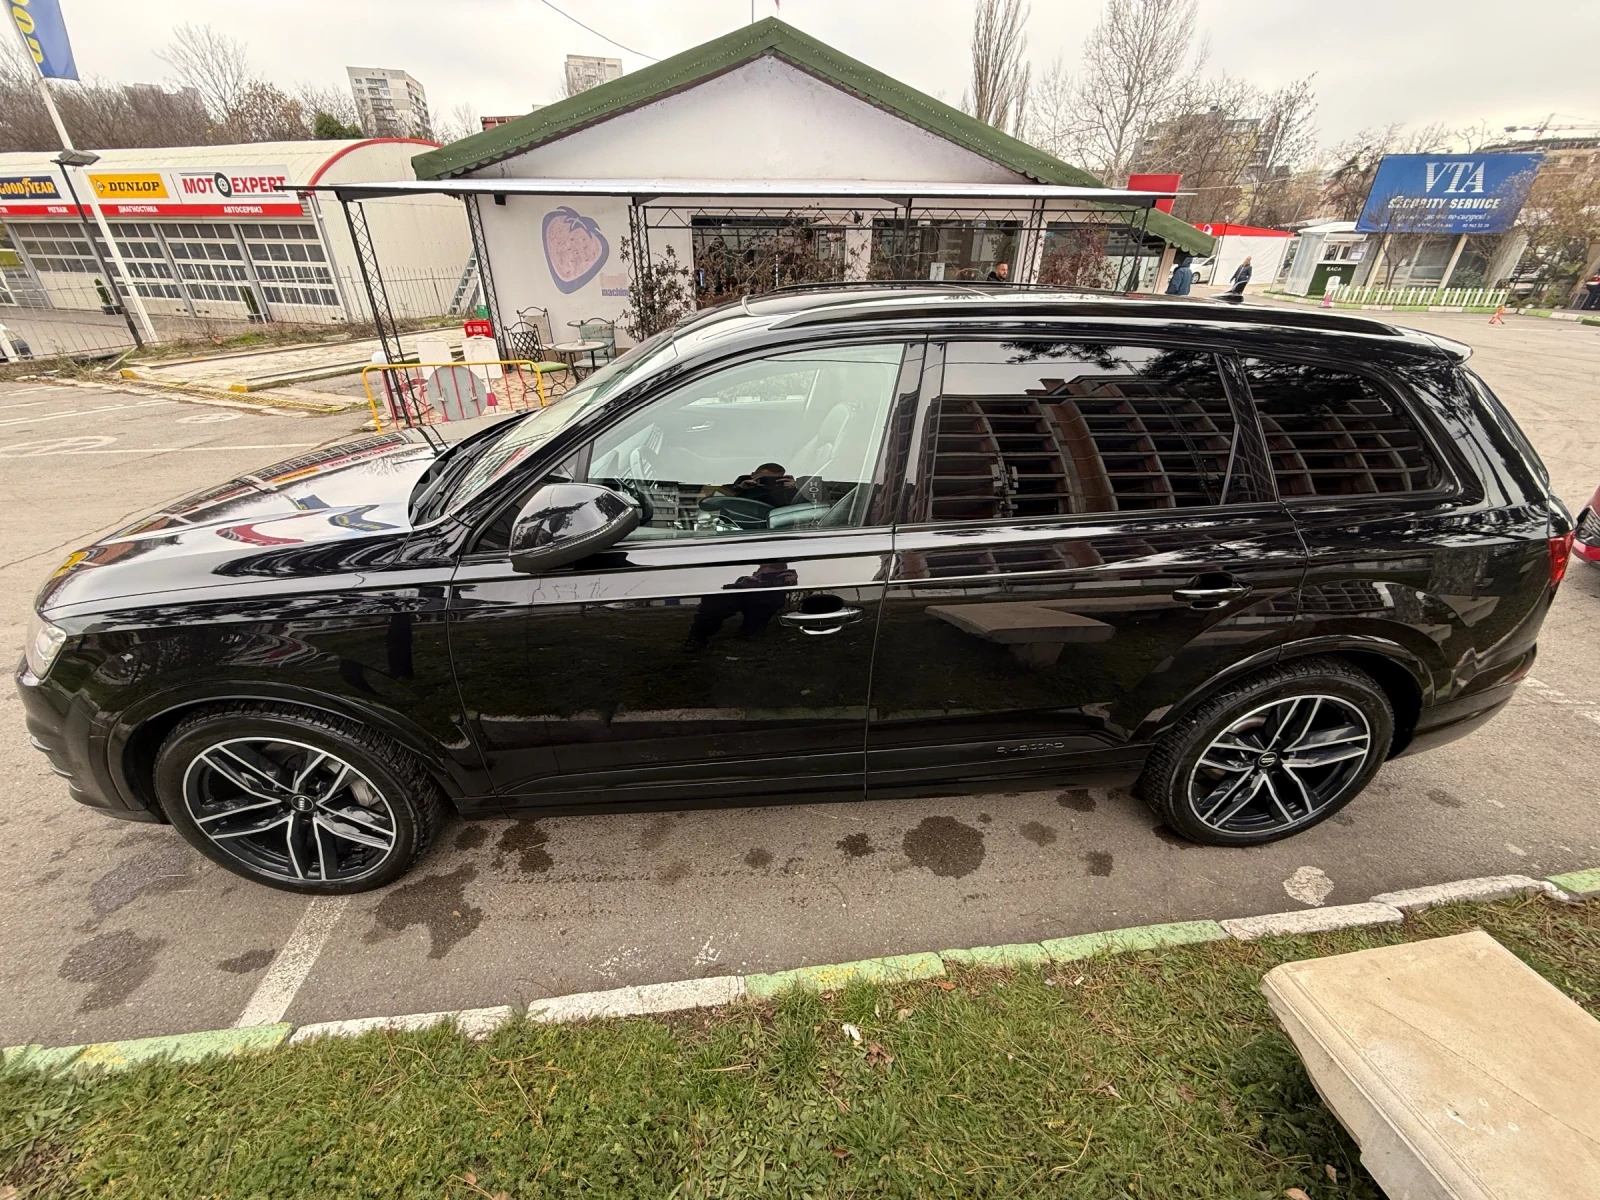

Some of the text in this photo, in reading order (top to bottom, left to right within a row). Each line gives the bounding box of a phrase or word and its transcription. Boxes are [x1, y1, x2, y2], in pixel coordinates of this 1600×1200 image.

[1425, 162, 1485, 192] VTA
[108, 181, 160, 192] DUNLOP
[1388, 196, 1501, 209] SECURITY SERVICE
[117, 205, 159, 213] ДИАГНОСТИКА
[223, 205, 263, 214] АВТОСЕРВИЗ
